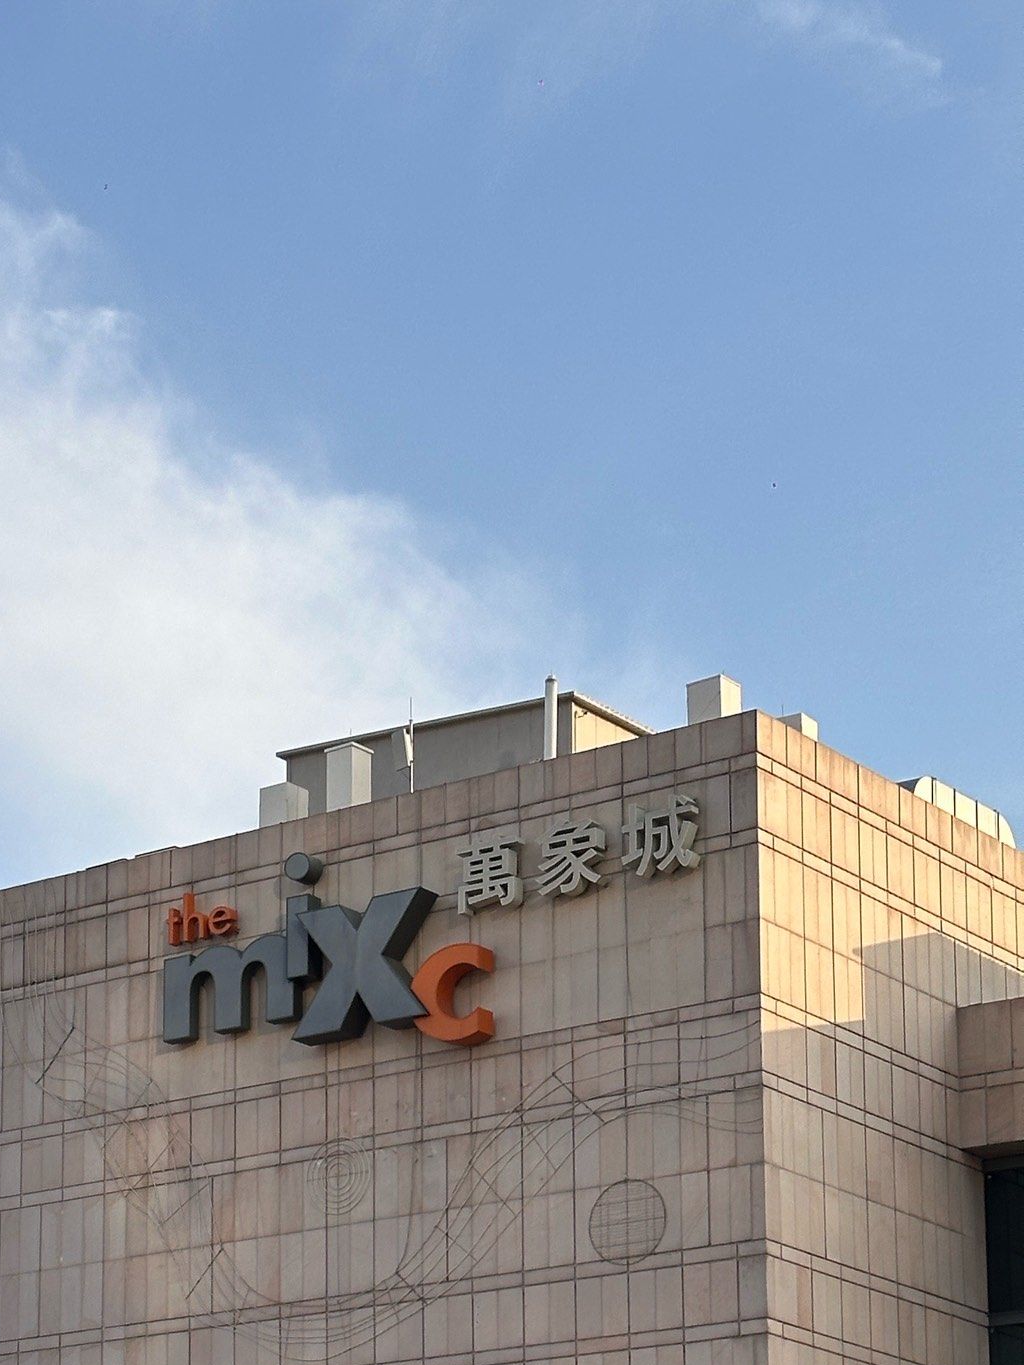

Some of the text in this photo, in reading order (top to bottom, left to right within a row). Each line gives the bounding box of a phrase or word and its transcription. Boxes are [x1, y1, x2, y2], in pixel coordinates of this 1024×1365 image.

[456, 795, 702, 917] 萬象城
[167, 892, 240, 946] the
